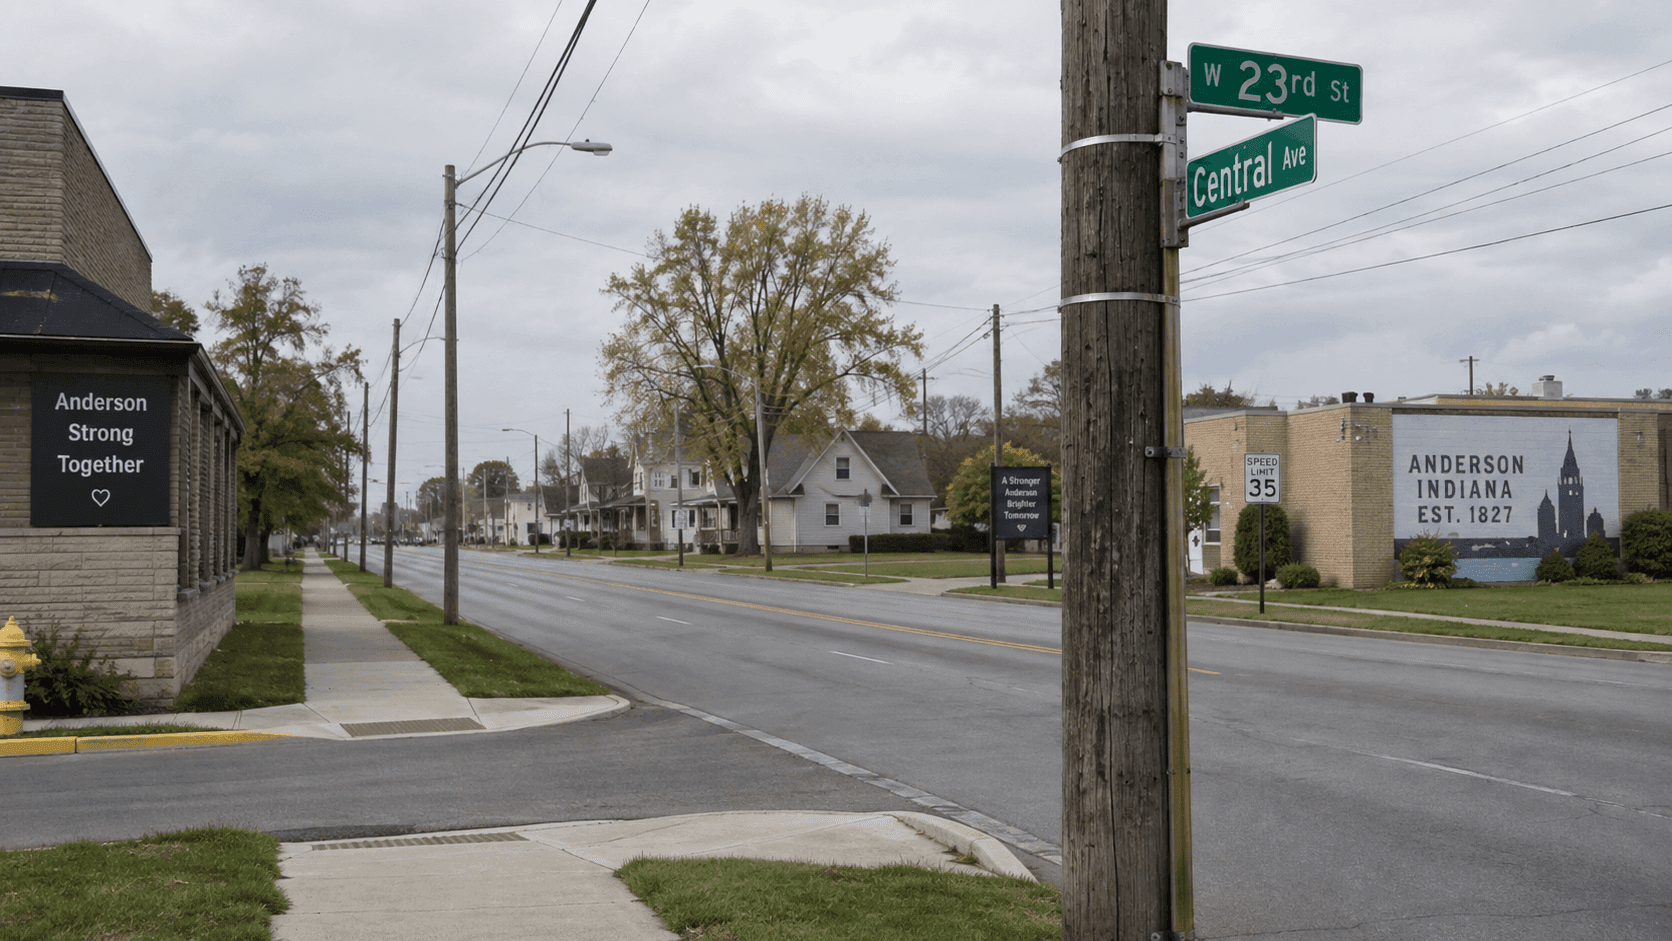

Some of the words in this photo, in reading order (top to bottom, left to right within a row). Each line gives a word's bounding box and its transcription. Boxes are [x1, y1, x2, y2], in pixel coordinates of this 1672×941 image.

[1204, 62, 1221, 87] W
[1238, 60, 1316, 105] 23rd
[1330, 80, 1349, 103] St
[1193, 141, 1272, 208] Central
[1282, 145, 1306, 171] Ave
[54, 392, 147, 412] Anderson
[68, 423, 134, 447] Strong
[57, 454, 145, 478] Together
[1247, 457, 1277, 466] SPEED
[1408, 454, 1524, 474] ANDERSON
[1001, 476, 1008, 484] A
[1250, 468, 1275, 476] LIMIT
[1004, 488, 1037, 496] Anderson
[1249, 478, 1276, 498] 35
[1417, 479, 1512, 499] INDIANA
[1004, 511, 1039, 519] Tomorrow
[1417, 505, 1461, 524] EST.
[1469, 505, 1513, 524] 1827
